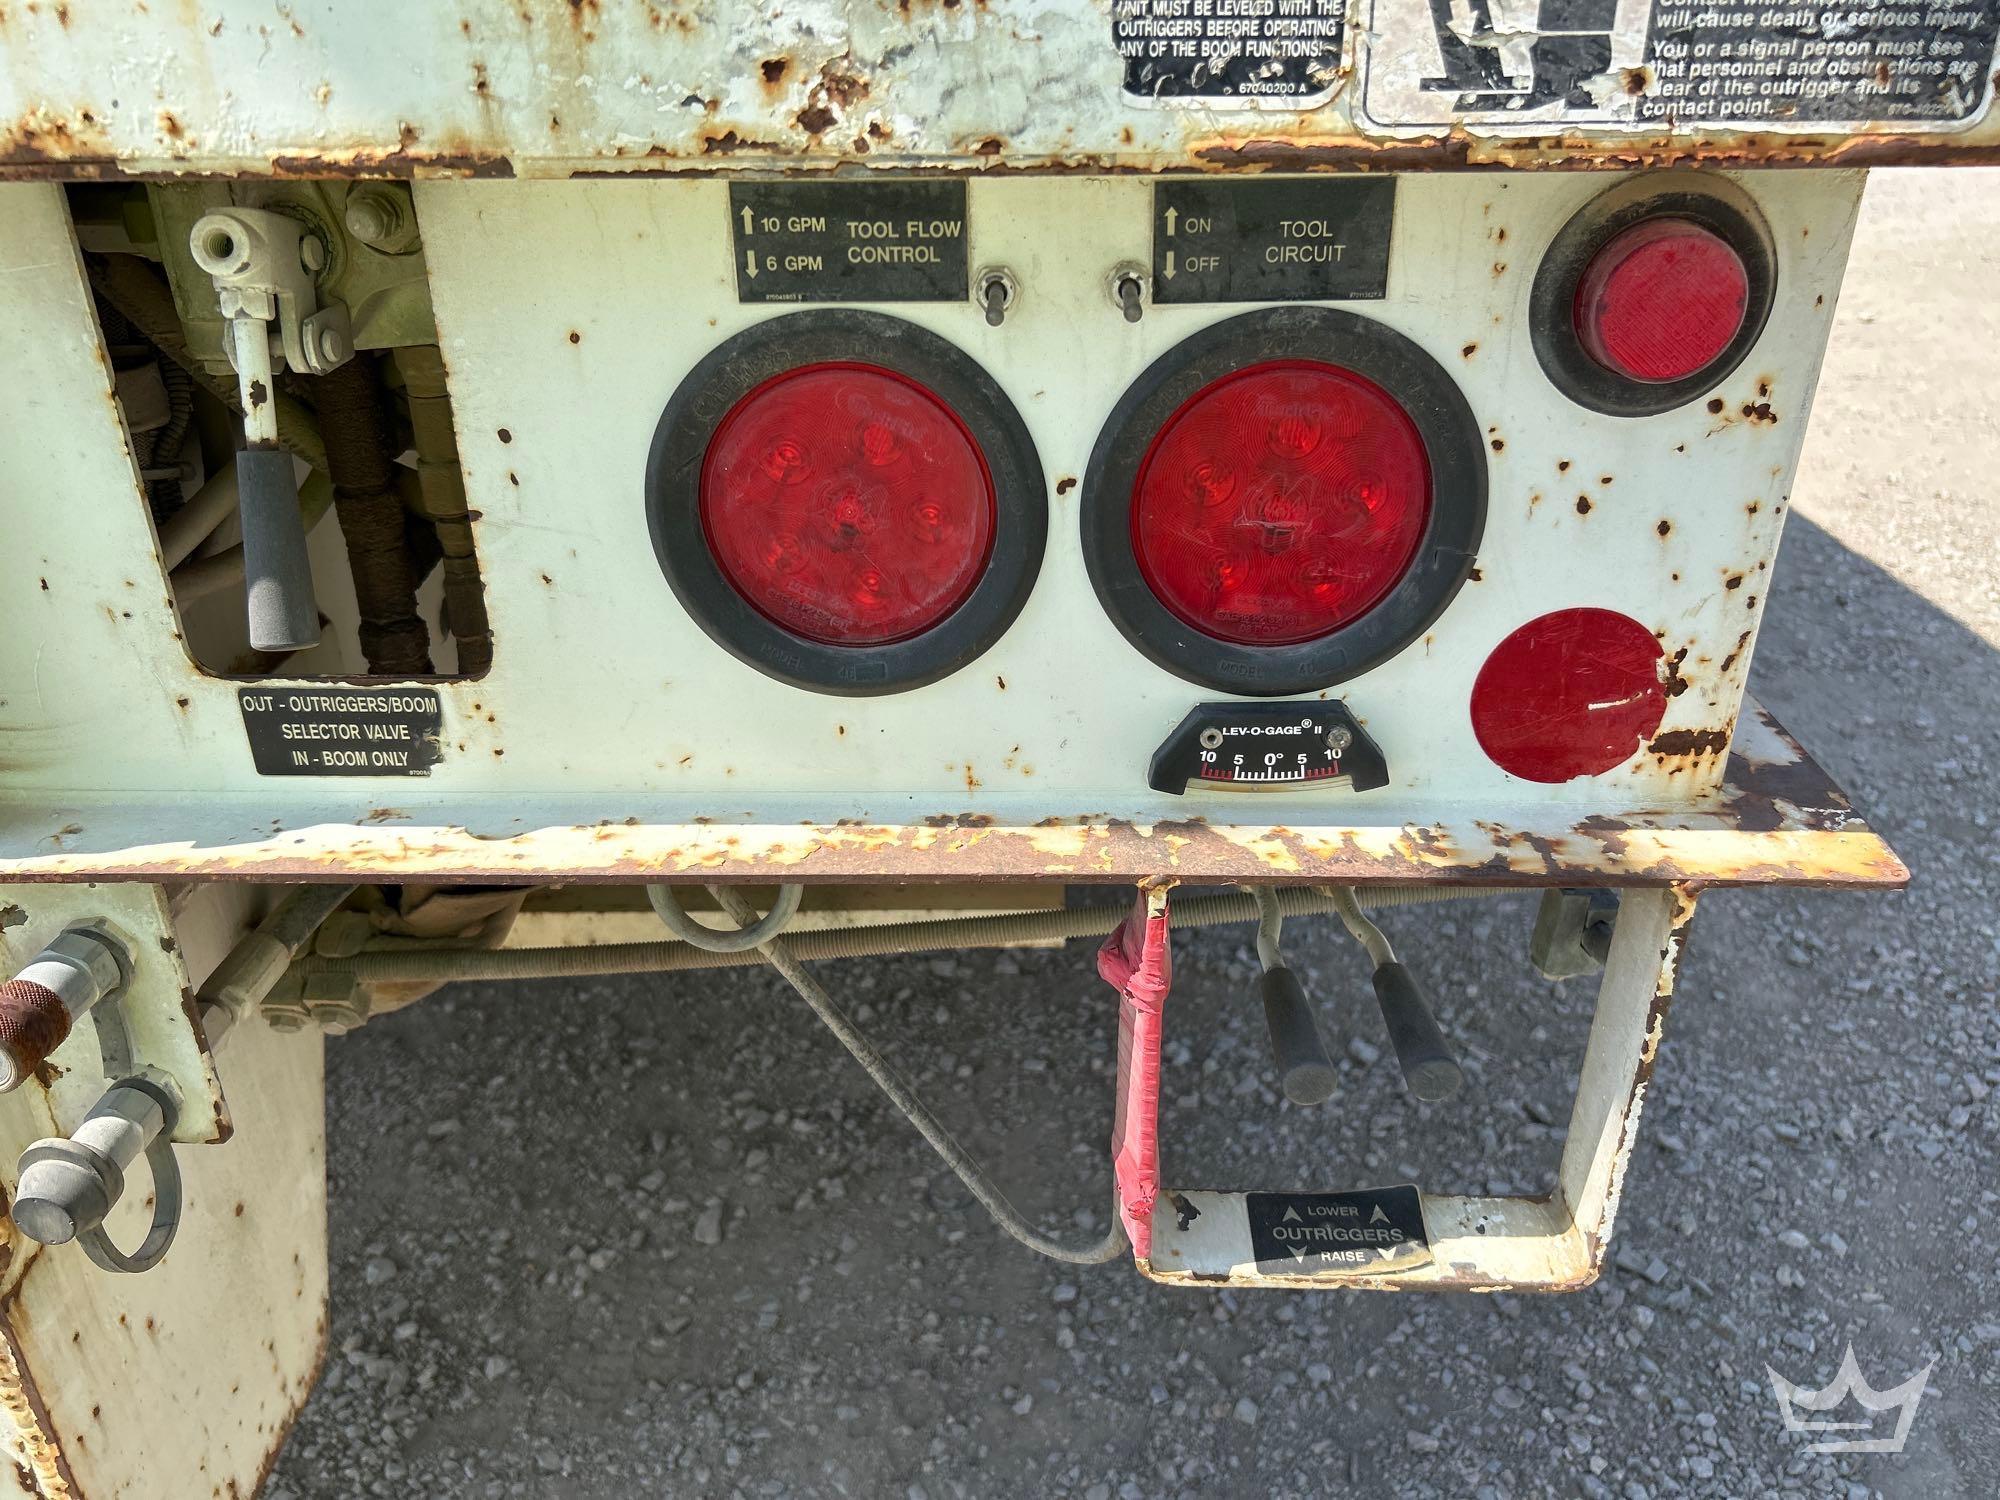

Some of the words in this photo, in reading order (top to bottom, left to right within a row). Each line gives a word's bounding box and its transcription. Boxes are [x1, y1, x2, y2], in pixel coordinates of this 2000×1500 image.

[1153, 0, 1189, 16] MUST
[1194, 0, 1212, 16] BE
[1279, 0, 1311, 16] WITH
[1316, 0, 1343, 16] THE
[1656, 9, 1691, 28] will
[1696, 13, 1755, 28] cause
[1760, 9, 1815, 28] death
[1847, 11, 1921, 28] serious
[1119, 20, 1202, 37] OUTRIGGERS
[1207, 20, 1260, 37] BEFORE
[1120, 40, 1144, 57] ANY
[1149, 40, 1168, 57] OF
[1171, 40, 1197, 57] THE
[1201, 40, 1241, 57] BOOM
[1653, 40, 1688, 58] You
[1694, 43, 1716, 58] or
[1720, 43, 1732, 58] a
[1738, 39, 1798, 61] signal
[1802, 42, 1871, 61] person
[1875, 39, 1925, 57] must
[1928, 41, 1965, 57] see
[1689, 59, 1783, 80] personnel
[1787, 58, 1826, 77] and
[1826, 58, 1945, 77] obstrctions
[1298, 83, 1307, 94] A
[1698, 80, 1719, 96] of
[1723, 79, 1757, 96] the
[1759, 77, 1850, 98] outrigger
[1641, 100, 1714, 117] contact
[1719, 98, 1775, 117] point.
[761, 217, 781, 233] 10
[787, 217, 827, 232] GPM
[847, 221, 899, 238] TOOL
[907, 220, 962, 238] FLOW
[1185, 218, 1212, 234] ON
[1279, 220, 1334, 238] TOOL
[847, 246, 941, 263] CONTROL
[1265, 244, 1347, 264] CIRCUIT
[766, 256, 778, 271] 6
[784, 256, 823, 271] GPM
[1185, 256, 1220, 273] OFF
[242, 696, 274, 712] OUT
[289, 696, 438, 714] OUTRIGGERS/BOOM
[281, 723, 361, 740] SELECTOR
[363, 724, 411, 740] VALVE
[292, 751, 309, 766] IN
[323, 751, 369, 766] BOOM
[372, 751, 409, 767] ONLY
[1200, 750, 1217, 763] 10
[1233, 754, 1244, 765] 5
[1297, 753, 1307, 764] 5
[1324, 748, 1342, 761] 10
[1307, 1205, 1359, 1217] LOWER
[1272, 1226, 1404, 1242] OUTRIGGERS
[1321, 1250, 1366, 1262] RAISE
